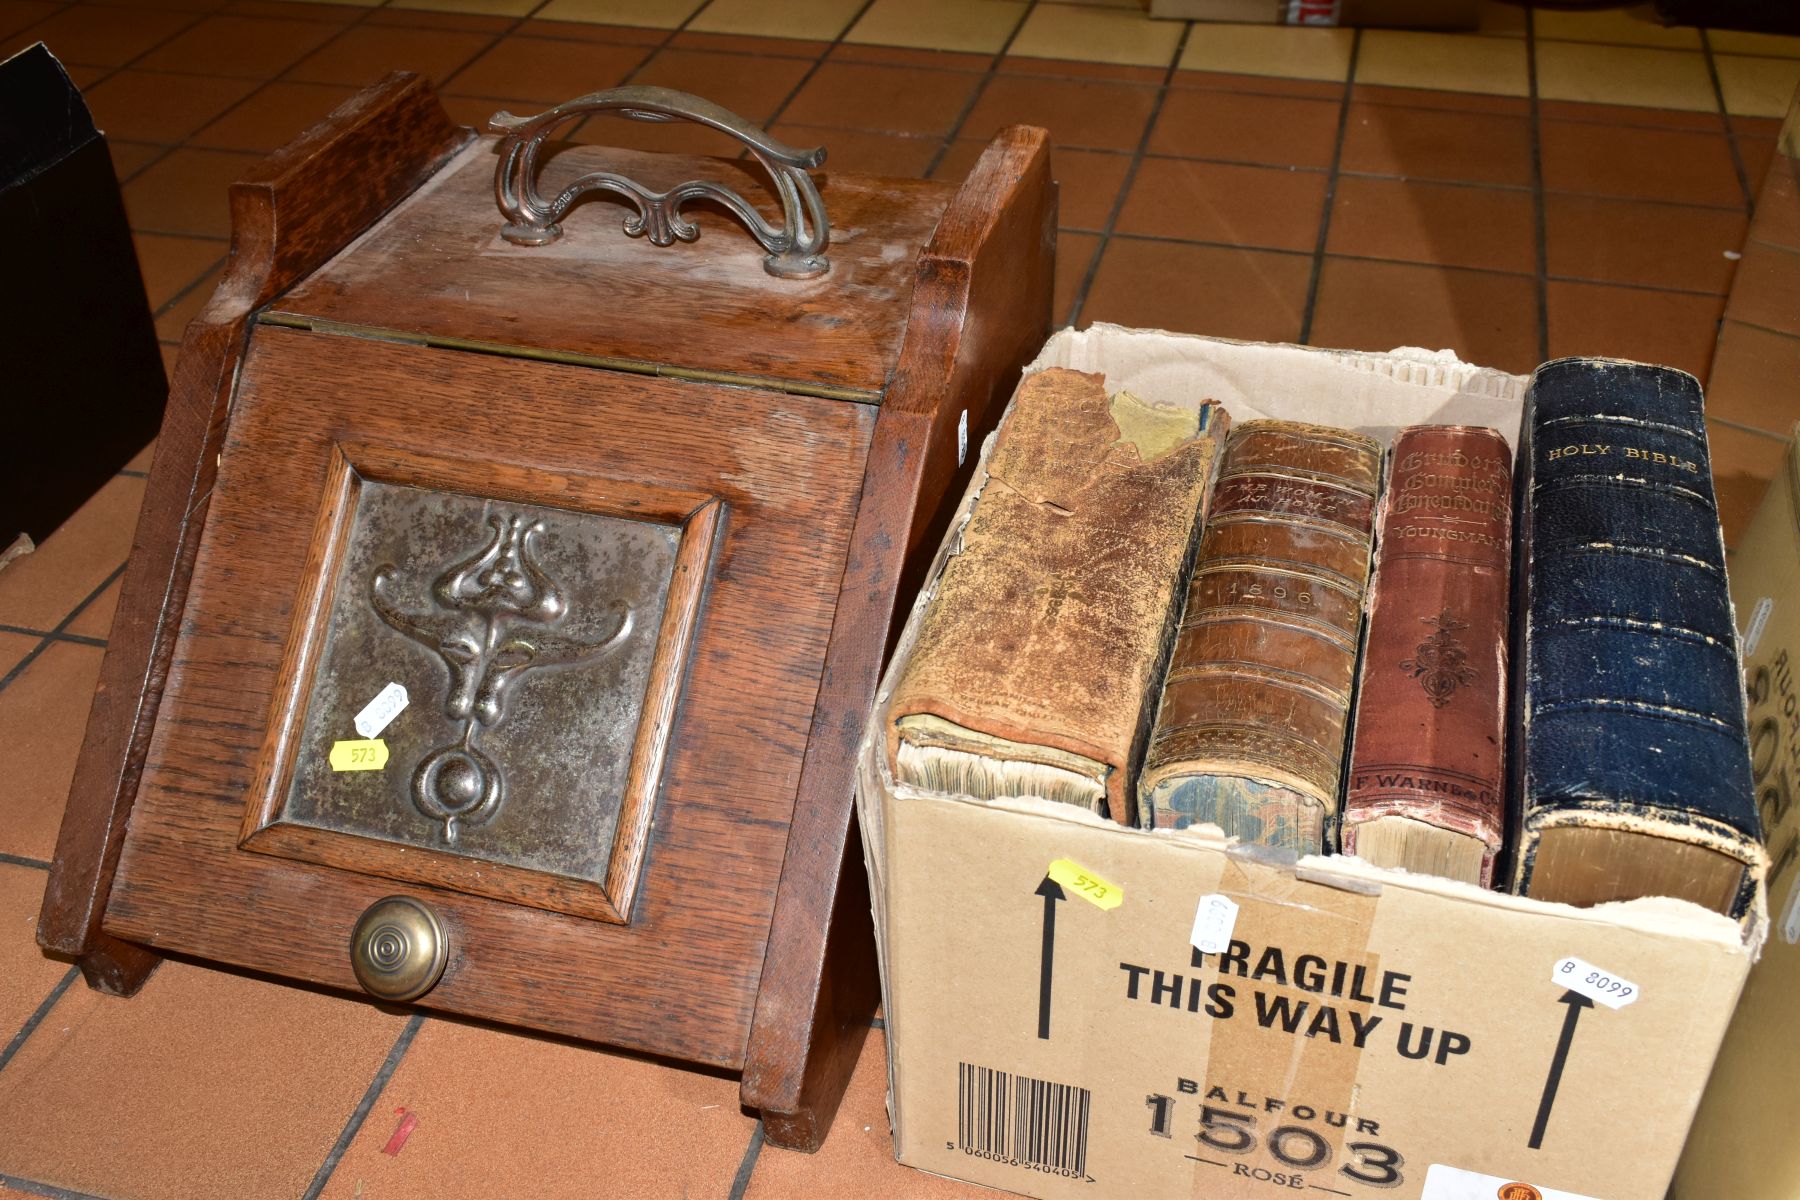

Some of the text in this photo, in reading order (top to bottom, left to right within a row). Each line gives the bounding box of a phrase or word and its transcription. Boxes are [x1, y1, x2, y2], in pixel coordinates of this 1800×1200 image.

[1548, 445, 1698, 474] HOLY BIBLE
[351, 746, 376, 764] 573
[1356, 776, 1369, 790] F
[1376, 773, 1461, 797] WARNE
[1073, 875, 1107, 899] 573
[1561, 961, 1633, 998] B 8099
[1119, 962, 1472, 1066] THIS WAY UP
[1177, 1077, 1380, 1136] BALFOUR
[1146, 1093, 1406, 1189] 1503
[1233, 1162, 1305, 1189] ROSÉ
